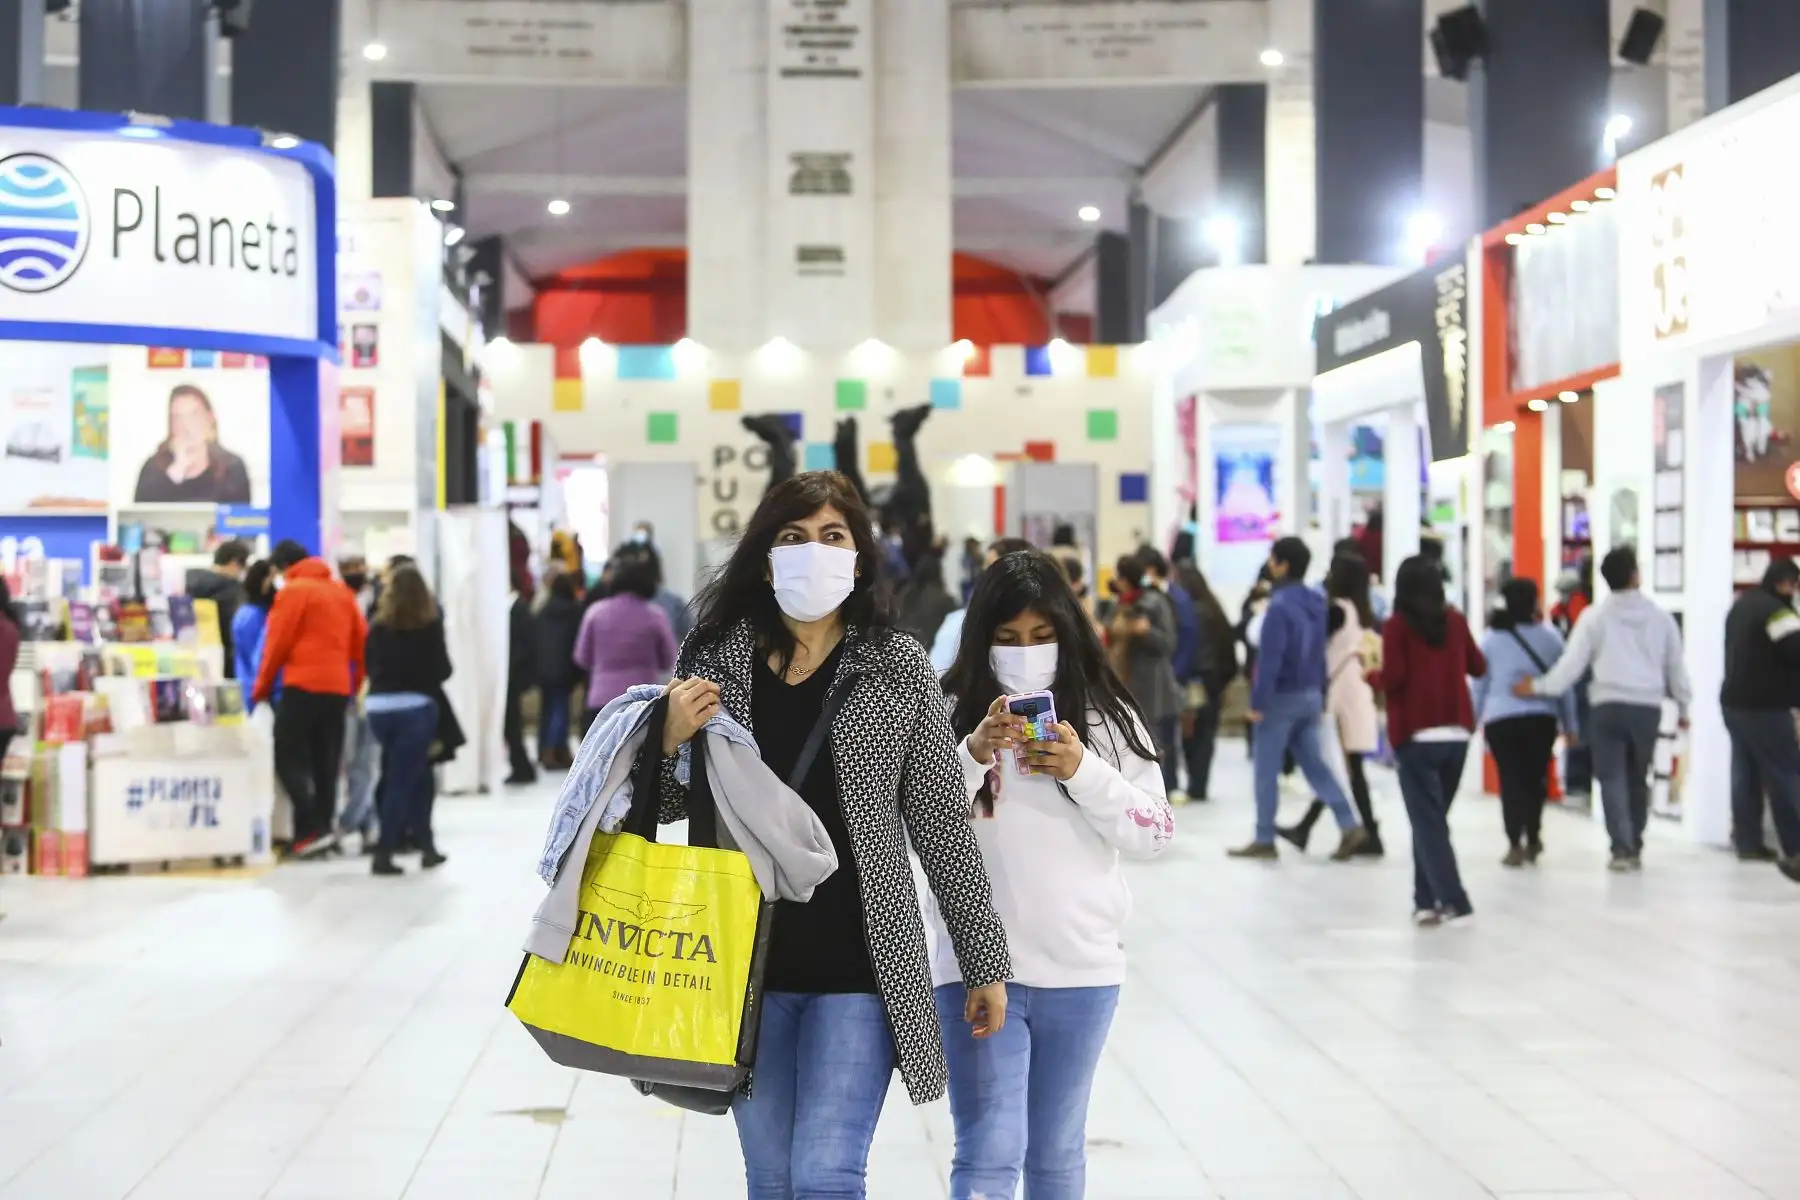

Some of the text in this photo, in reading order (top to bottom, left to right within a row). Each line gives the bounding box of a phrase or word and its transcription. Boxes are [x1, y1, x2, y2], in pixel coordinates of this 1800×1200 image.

[113, 185, 297, 277] Planeta
[573, 909, 717, 963] INVICTA
[563, 948, 712, 991] INVINCIBLE IN DETAIL
[612, 990, 651, 1006] SINCE 1837
